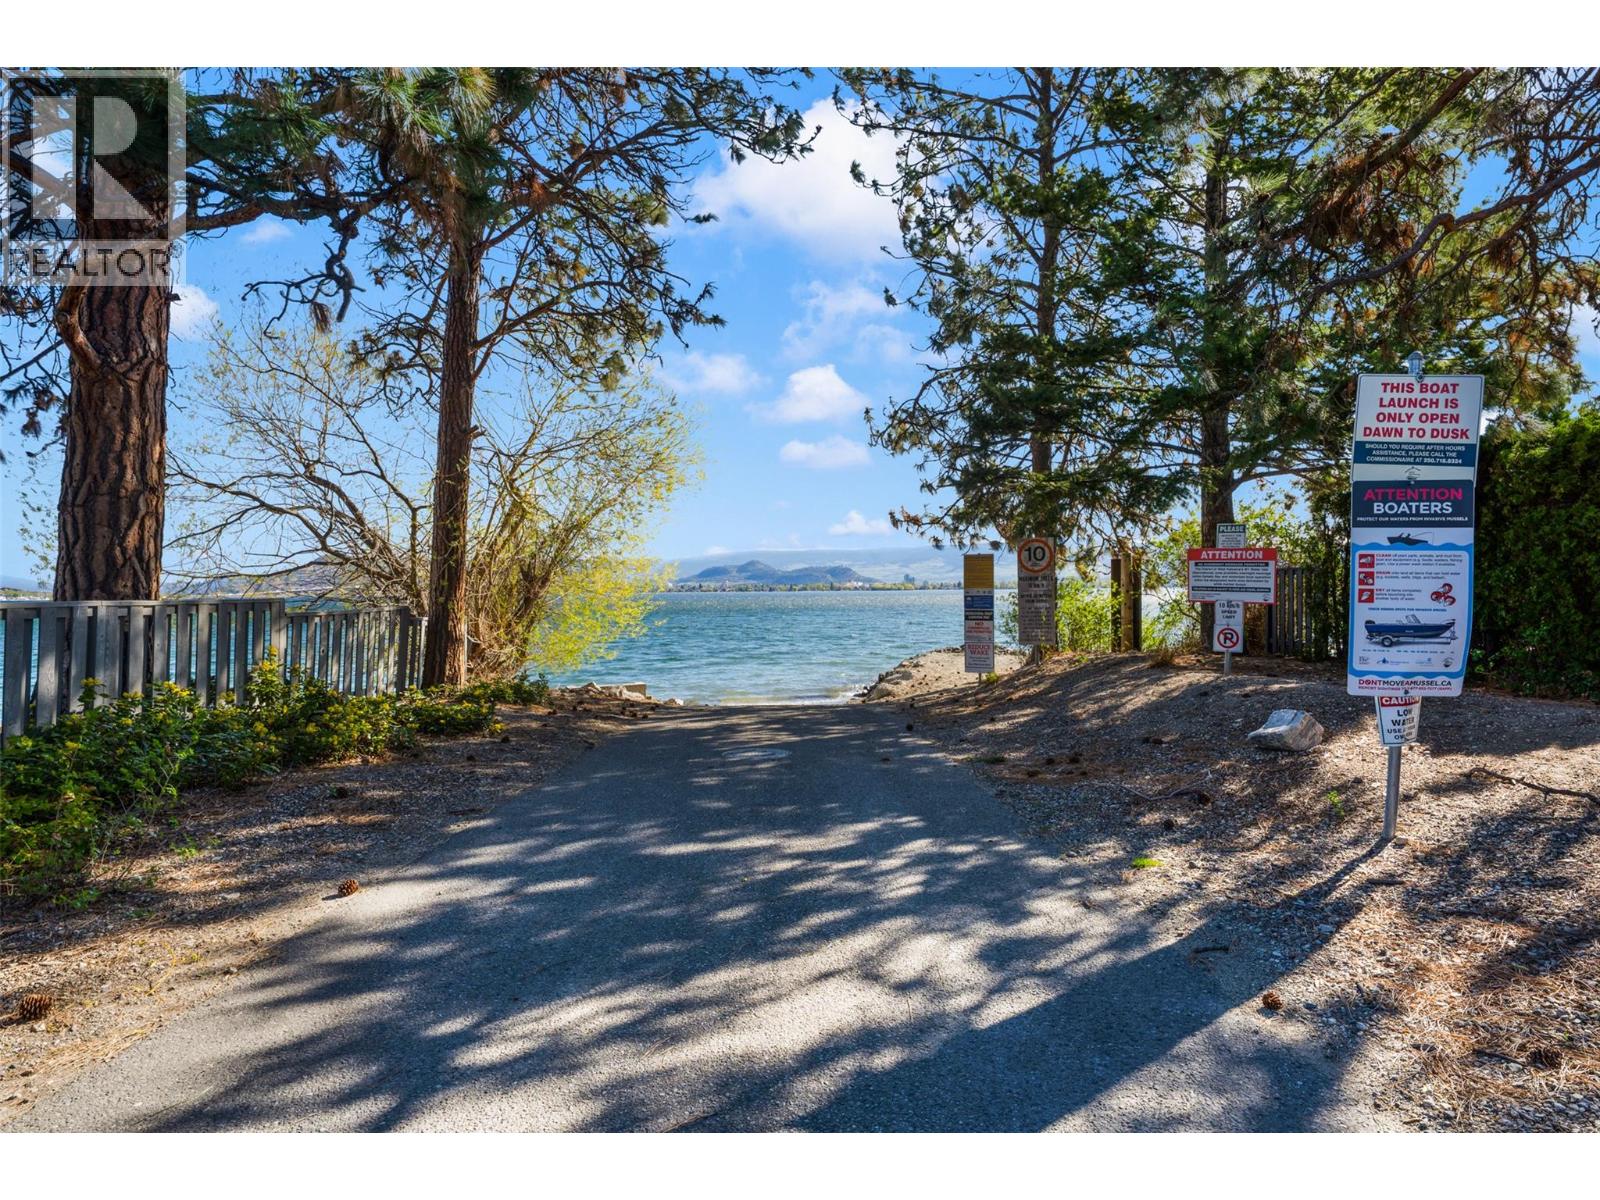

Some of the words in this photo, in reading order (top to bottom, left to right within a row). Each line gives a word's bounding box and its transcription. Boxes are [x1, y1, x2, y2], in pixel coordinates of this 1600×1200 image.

[1381, 383, 1414, 393] THIS
[1419, 383, 1459, 394] BOAT
[1379, 398, 1439, 409] LAUNCH
[1444, 398, 1459, 409] IS
[1376, 412, 1414, 423] ONLY
[1418, 413, 1460, 423] OPEN
[1363, 427, 1403, 438] DAWN
[1407, 428, 1426, 438] TO
[1430, 428, 1470, 439] DUSK
[1364, 488, 1463, 500] ATTENTION
[1373, 502, 1452, 514] BOATERS
[1024, 546, 1046, 561] 10
[1201, 550, 1263, 559] ATTENTION
